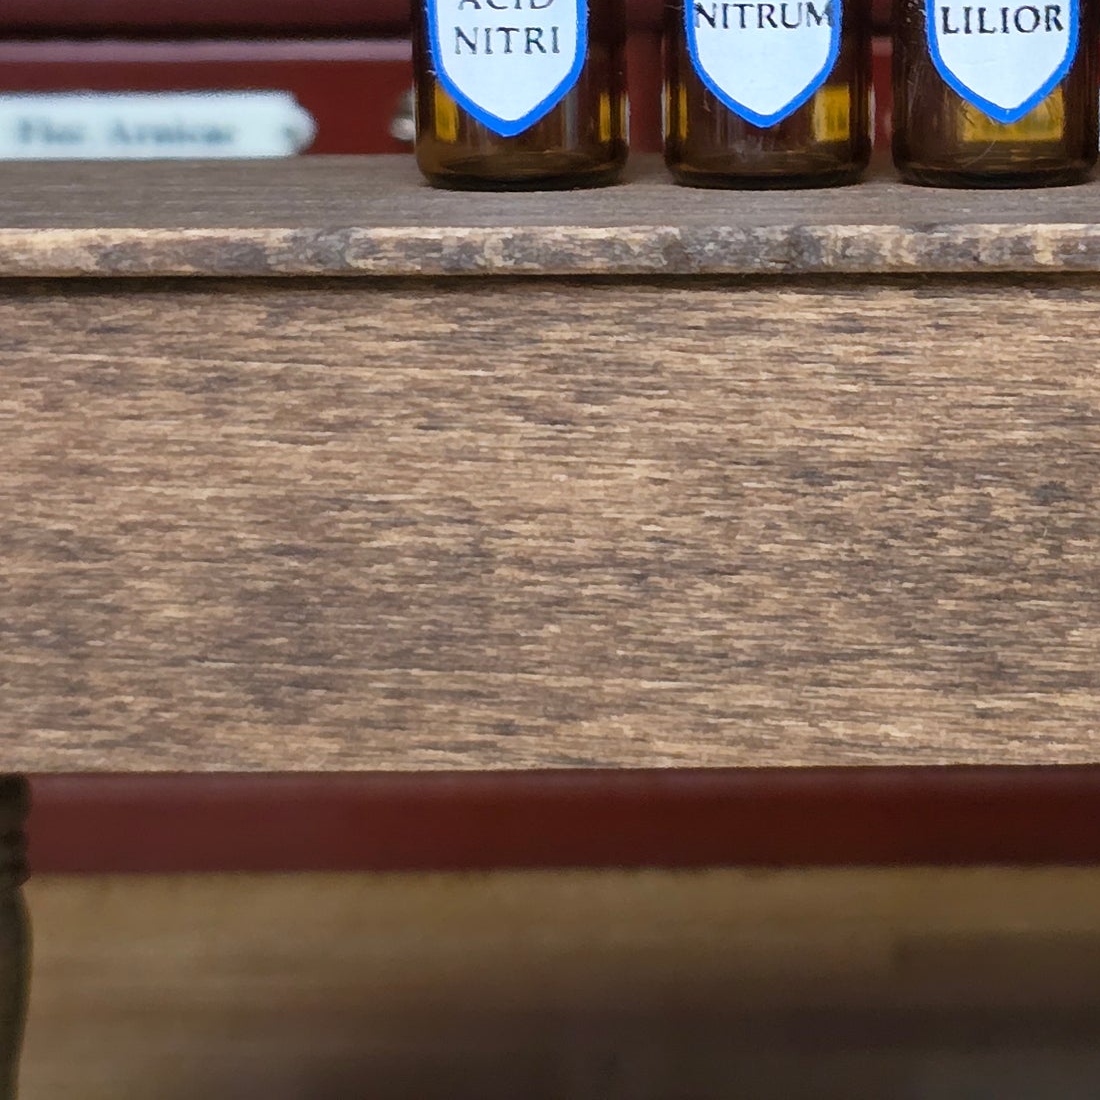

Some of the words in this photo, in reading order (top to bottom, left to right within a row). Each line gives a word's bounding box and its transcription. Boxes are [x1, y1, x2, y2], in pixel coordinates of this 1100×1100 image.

[695, 0, 834, 30] NITRUM
[940, 4, 1065, 35] LILIOR
[454, 26, 561, 55] NITRI
